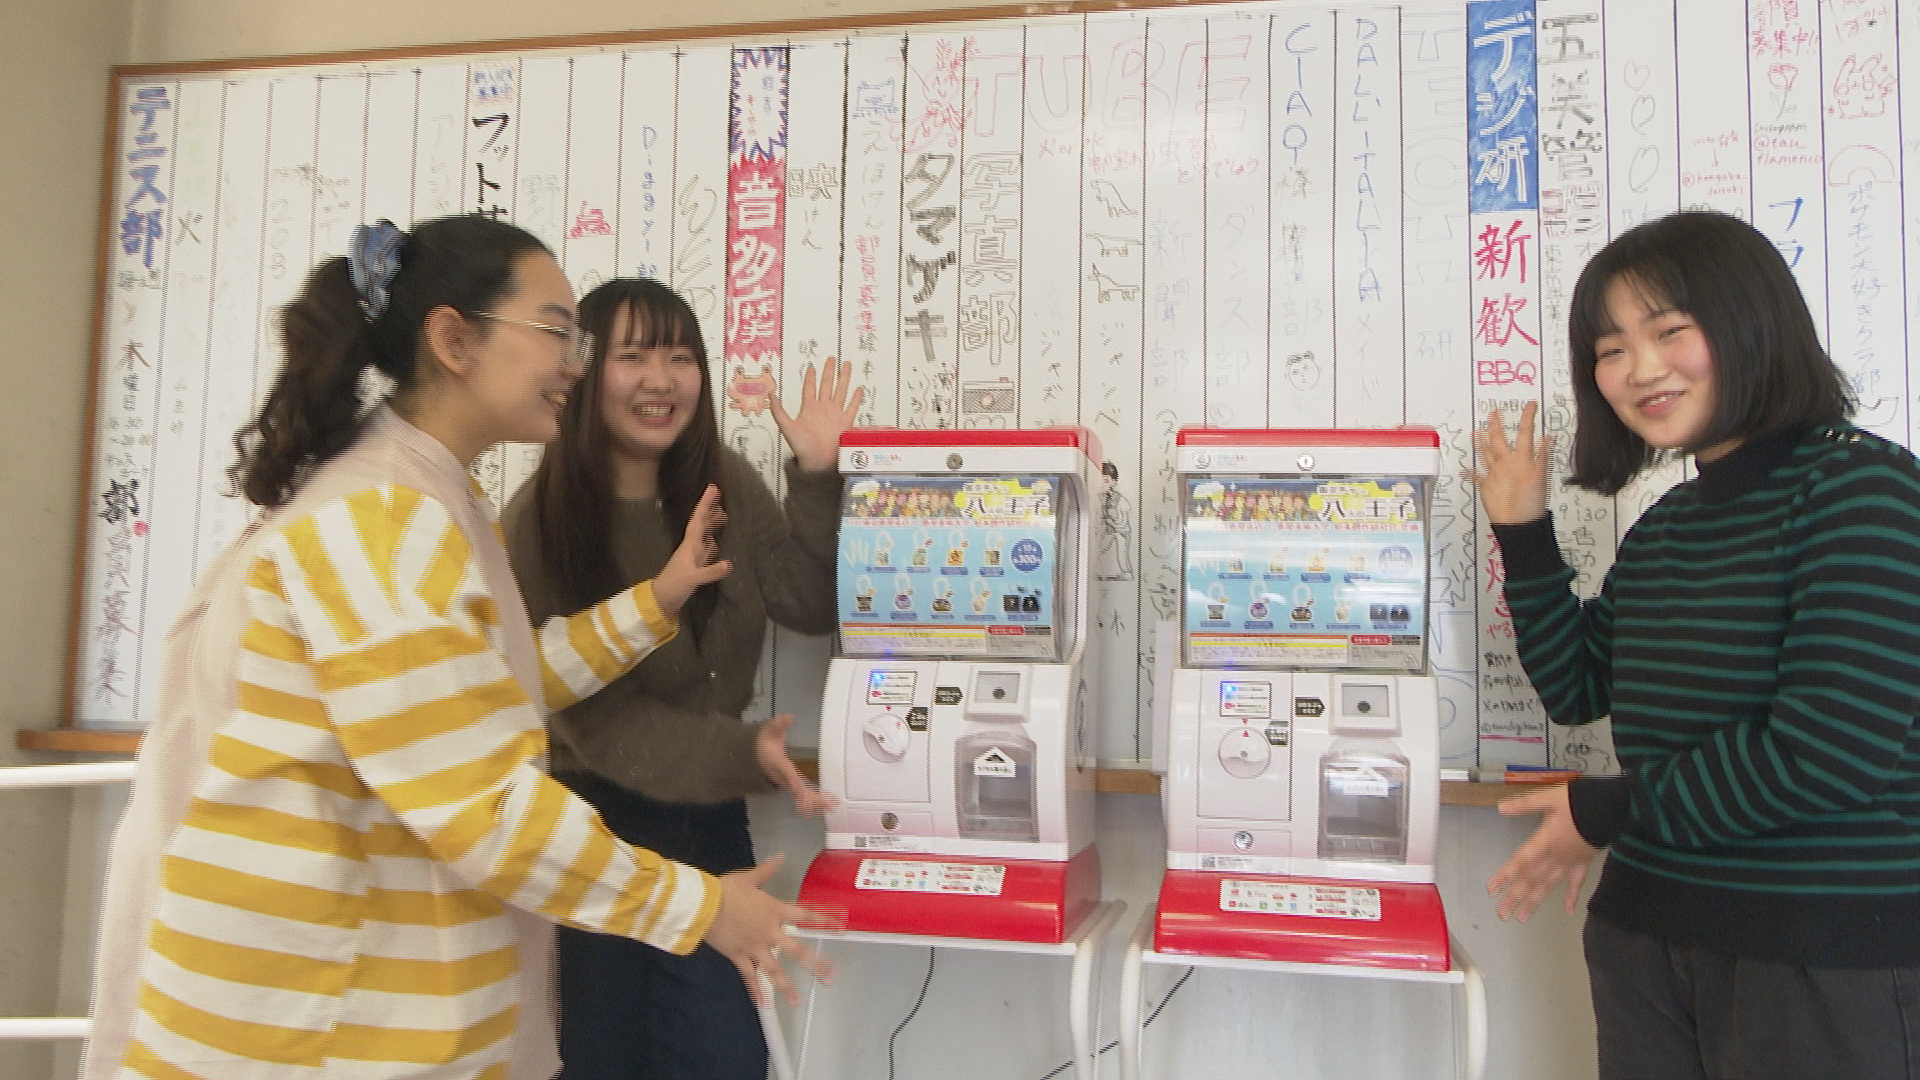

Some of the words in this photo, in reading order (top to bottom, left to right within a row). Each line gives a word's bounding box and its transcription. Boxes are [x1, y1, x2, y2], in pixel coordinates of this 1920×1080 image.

[118, 88, 171, 270] テニス部
[1474, 11, 1535, 204] デジ研
[903, 154, 958, 364] タマゲキ
[960, 153, 1022, 367] 写真部
[1149, 210, 1194, 395] 新聞部
[1214, 204, 1256, 390] ダンス部
[1473, 220, 1540, 349] 新歓
[1477, 360, 1538, 388] BBQ
